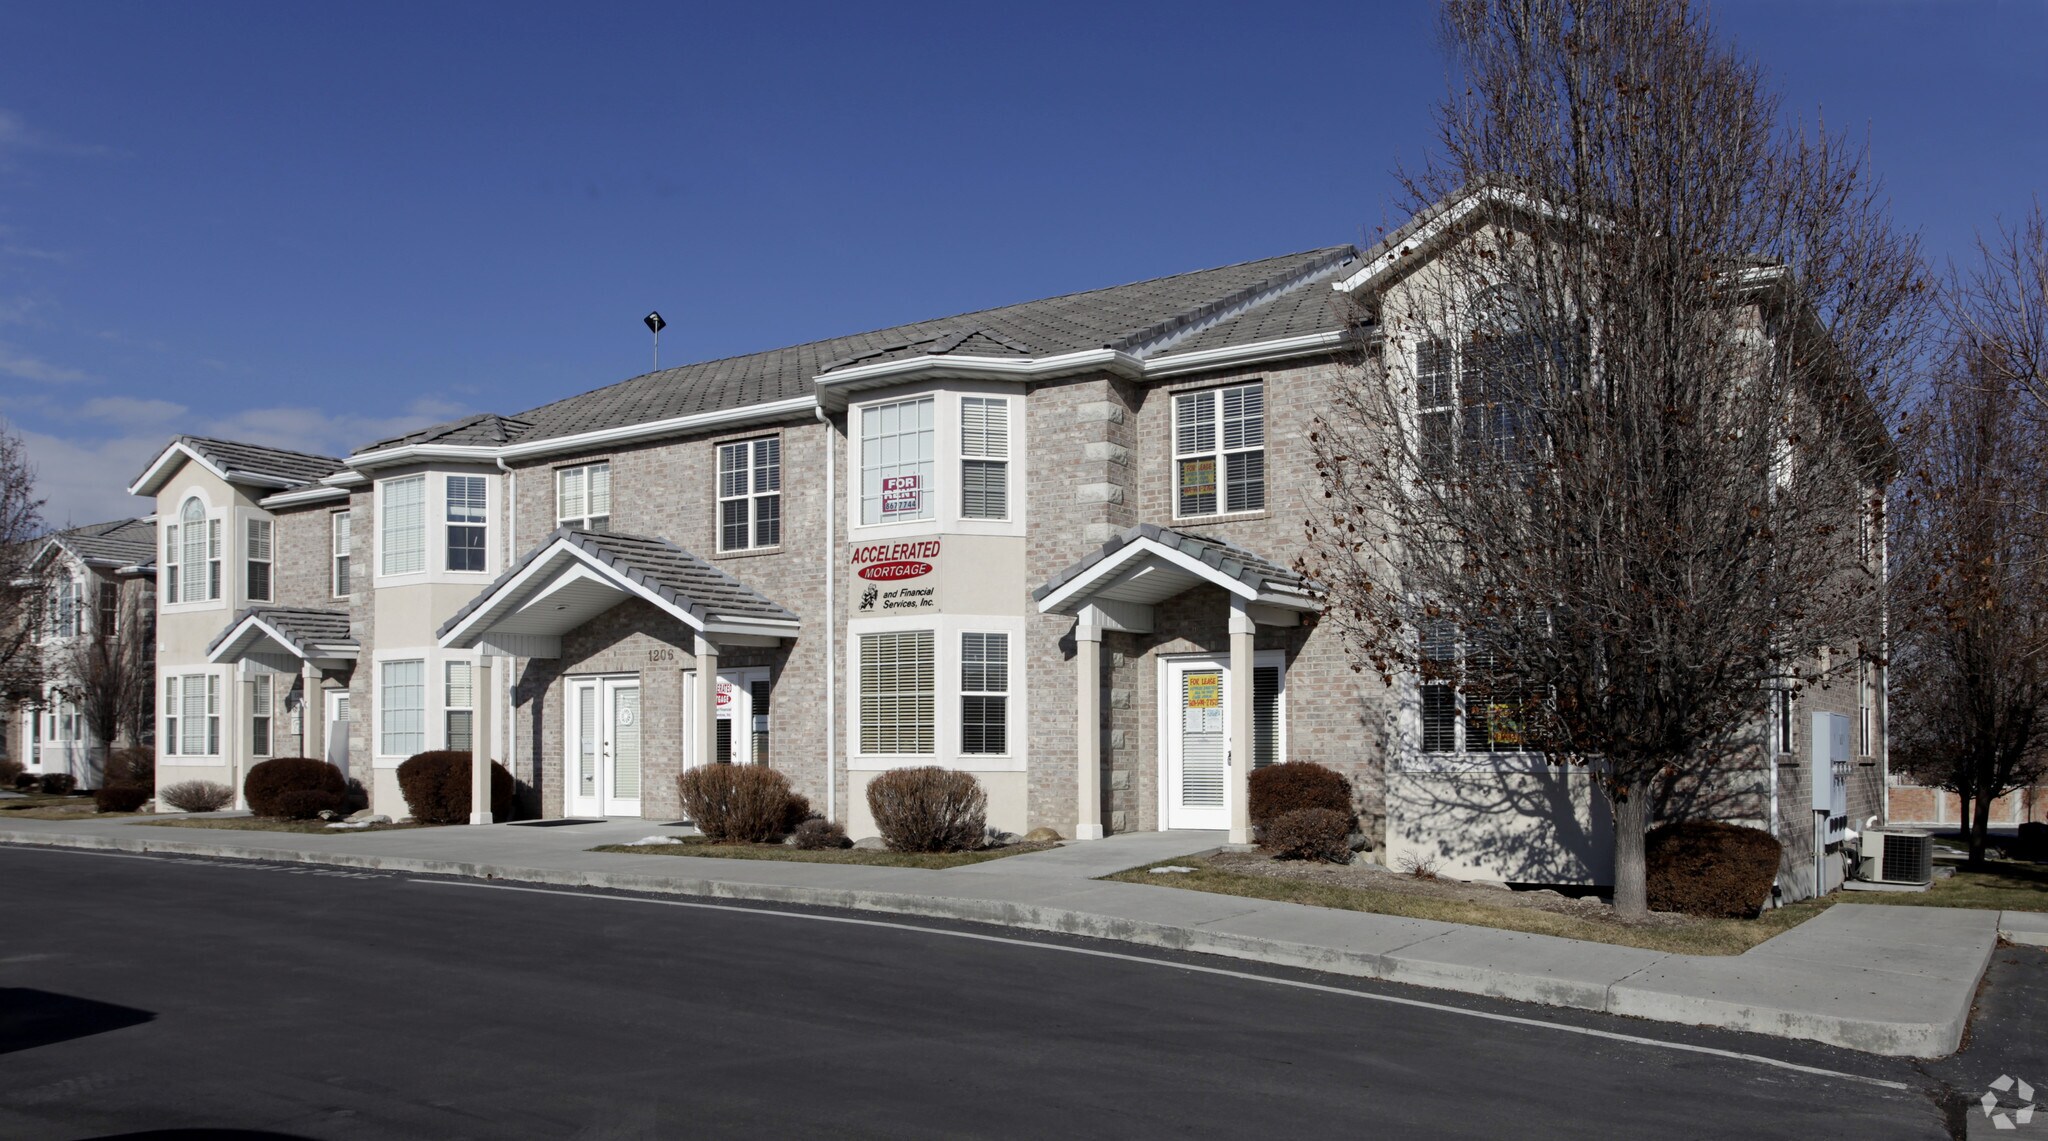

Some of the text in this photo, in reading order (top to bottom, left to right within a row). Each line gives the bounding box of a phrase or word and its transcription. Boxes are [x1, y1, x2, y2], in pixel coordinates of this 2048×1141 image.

[888, 478, 914, 489] FOR
[884, 488, 916, 499] RENT
[851, 540, 941, 565] ACCELERATED
[864, 563, 927, 578] MORTGAGE
[883, 587, 935, 599] and Financial
[883, 597, 934, 609] Services, Inc.
[648, 649, 674, 662] 1206
